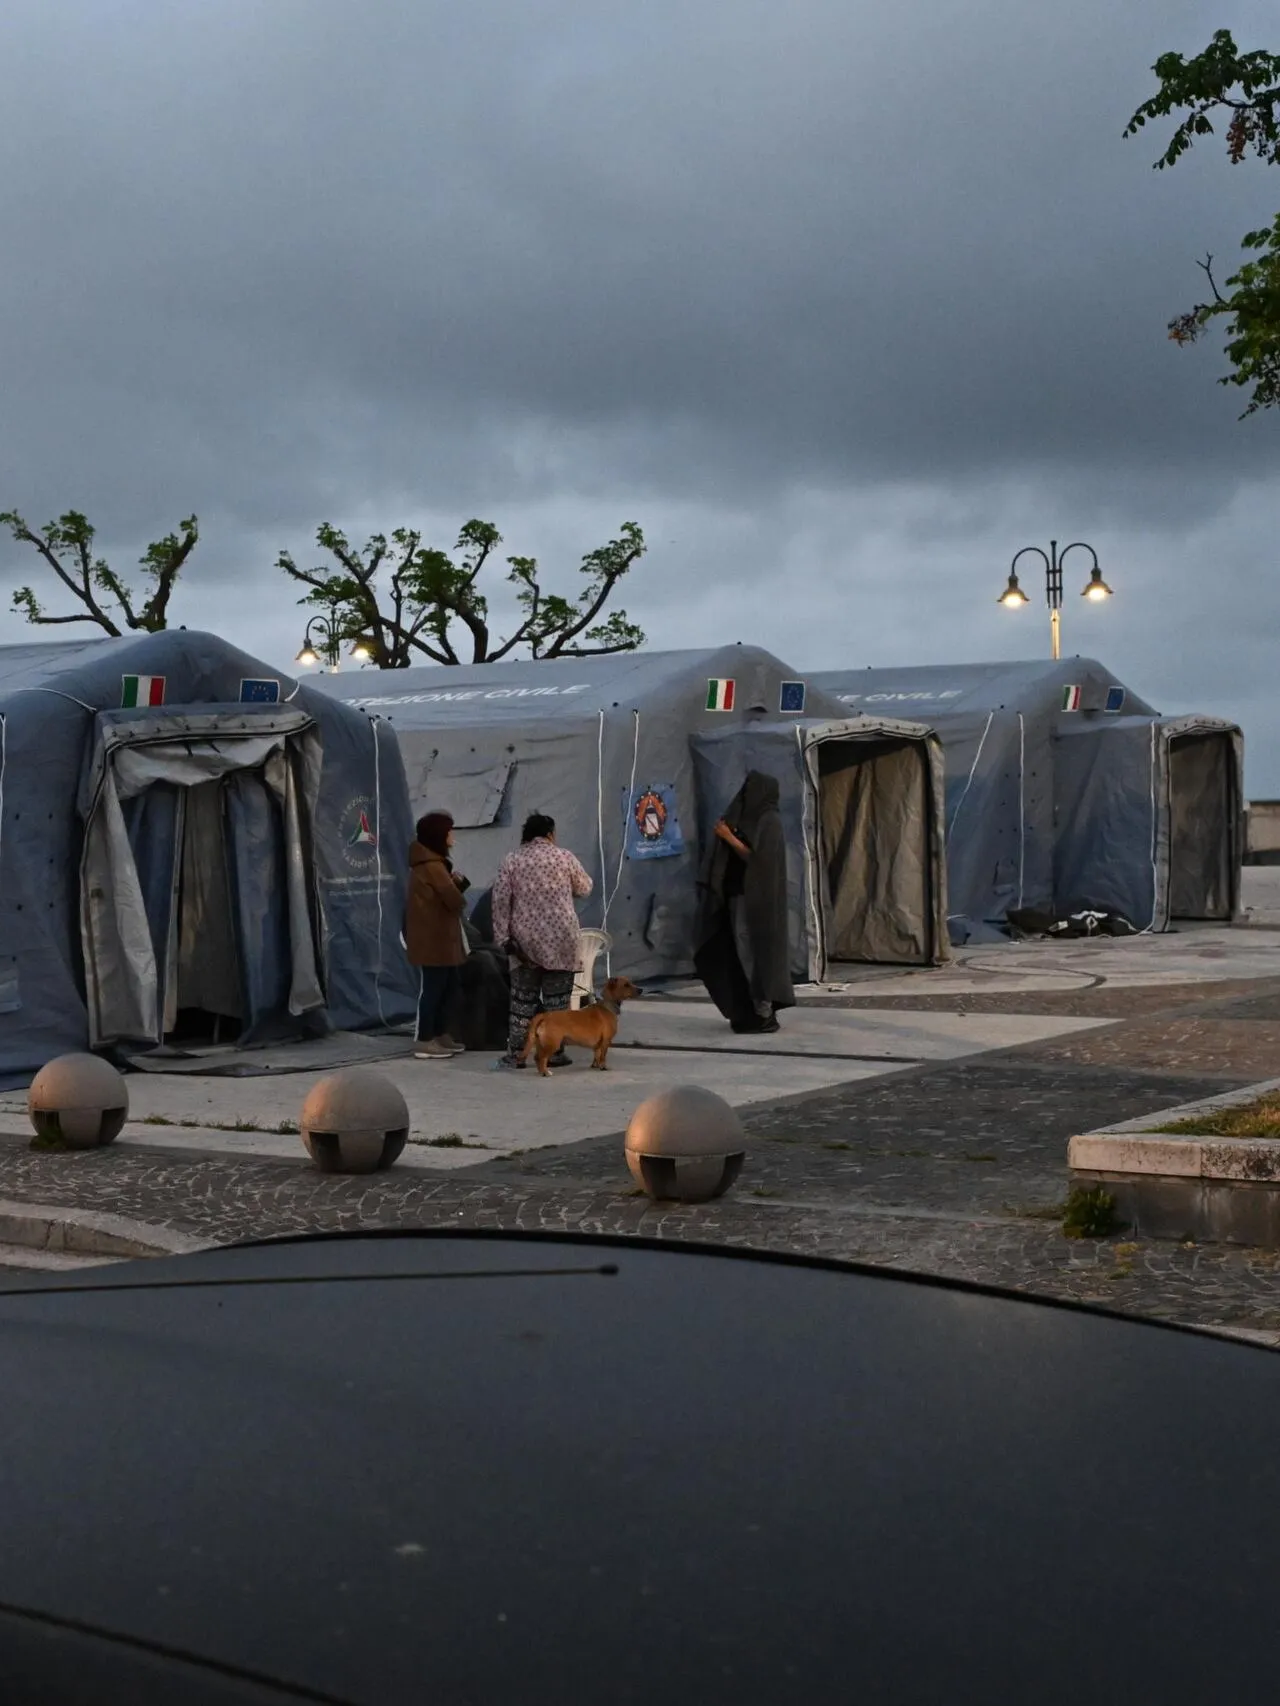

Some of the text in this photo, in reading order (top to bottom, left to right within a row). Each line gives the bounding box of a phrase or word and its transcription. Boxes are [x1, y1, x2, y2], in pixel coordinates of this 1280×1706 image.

[339, 684, 592, 706] OTEZIONE CIVILE
[865, 690, 962, 702] CIVILE
